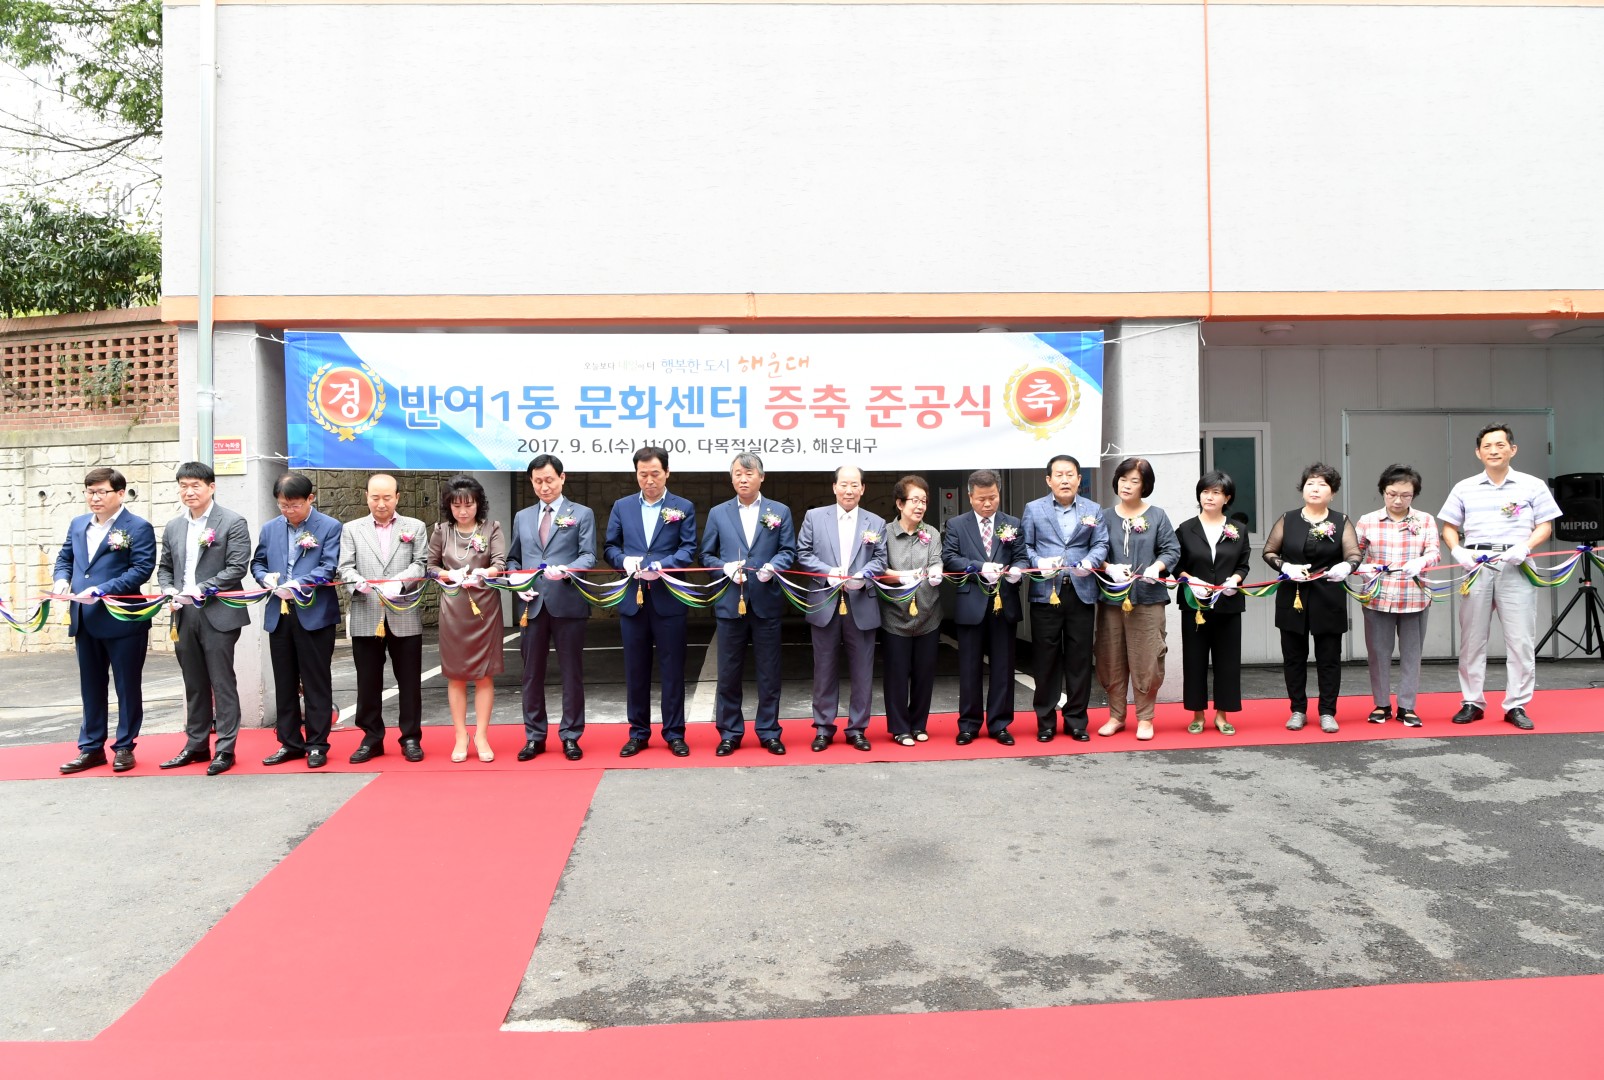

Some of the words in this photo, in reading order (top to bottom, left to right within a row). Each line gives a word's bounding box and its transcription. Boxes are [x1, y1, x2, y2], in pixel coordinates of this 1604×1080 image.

[660, 358, 701, 374] 행복한
[703, 358, 730, 373] 도시
[738, 352, 810, 378] 해운대
[329, 379, 360, 418] 경
[400, 384, 560, 430] 반여1동
[574, 385, 748, 429] 문화센터
[765, 384, 851, 430] 증축
[865, 384, 991, 430] 준공식
[1022, 378, 1061, 417] 축
[517, 438, 564, 454] 2017.
[570, 438, 586, 454] 9.
[592, 438, 636, 455] 6.(수)
[697, 438, 807, 456] 다목적실(2층),
[812, 438, 879, 455] 해운대구
[1560, 521, 1598, 530] MIPRO
